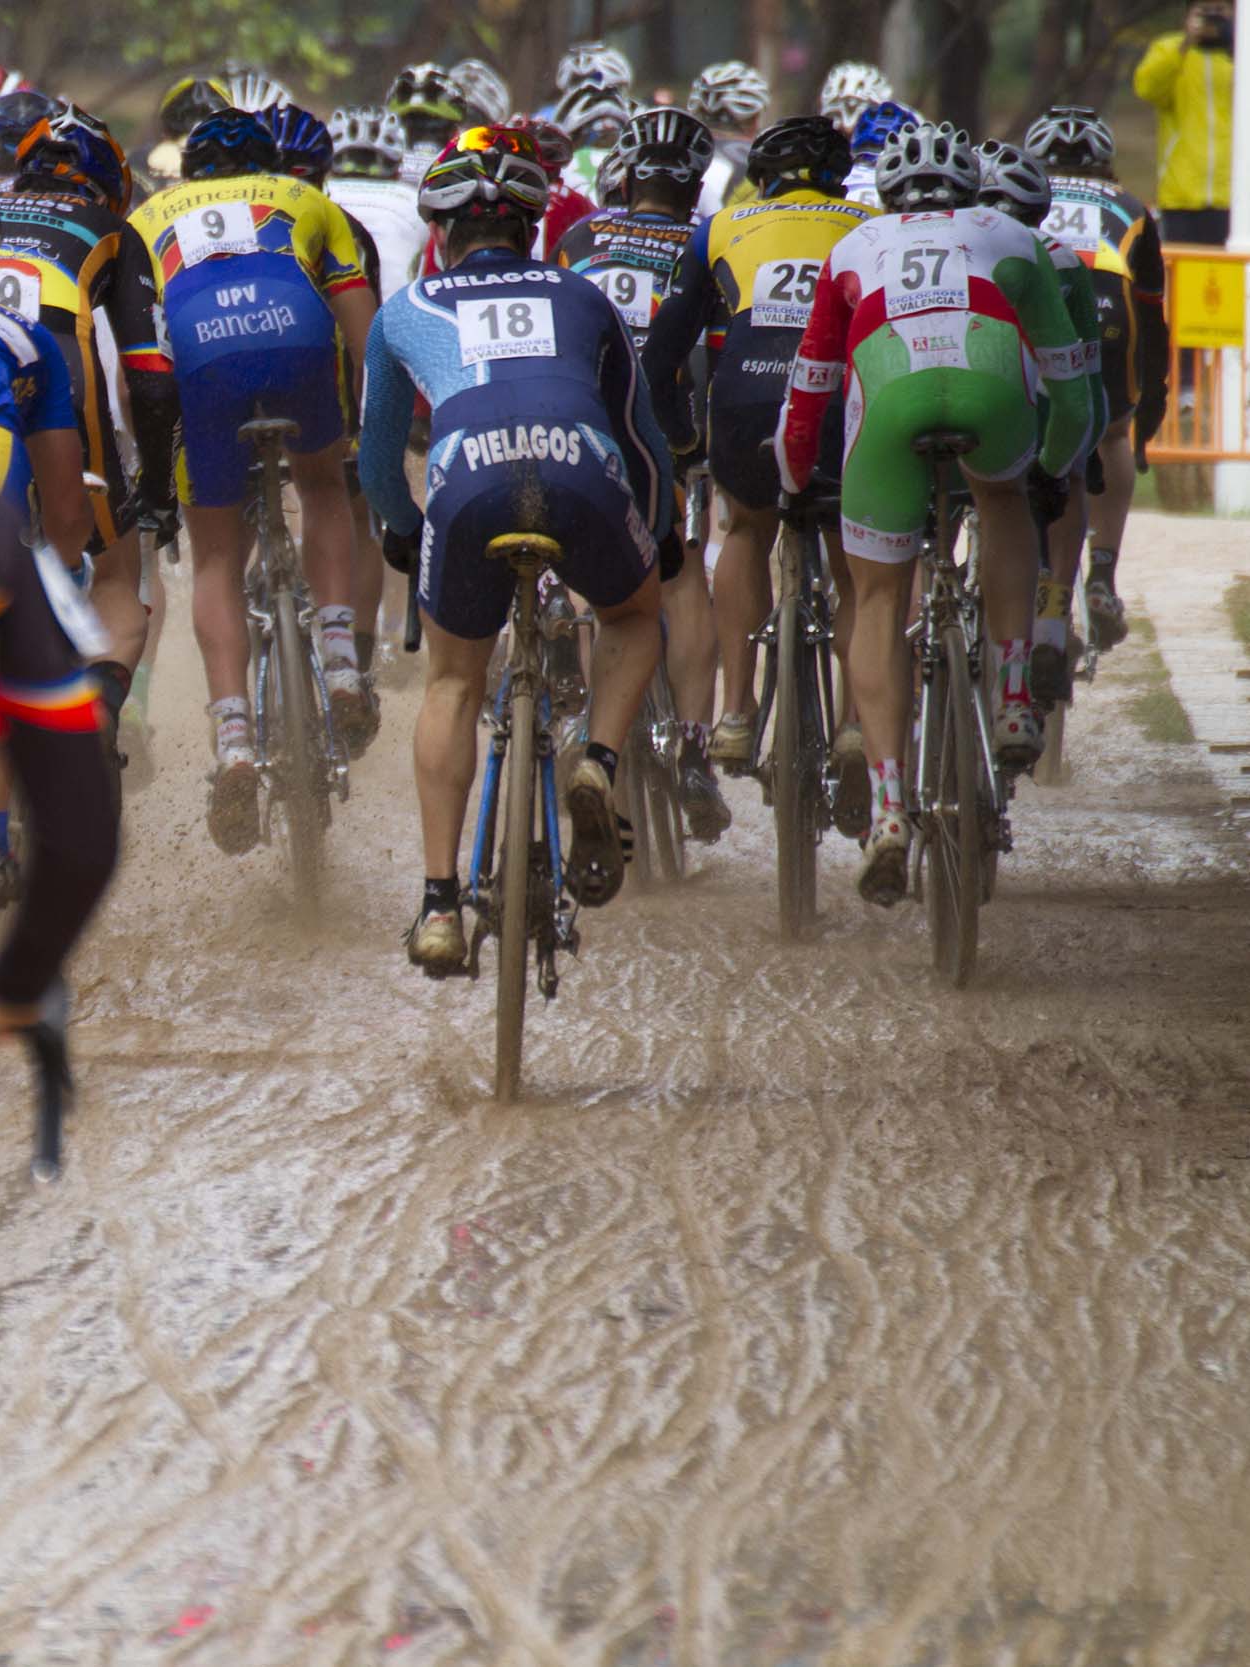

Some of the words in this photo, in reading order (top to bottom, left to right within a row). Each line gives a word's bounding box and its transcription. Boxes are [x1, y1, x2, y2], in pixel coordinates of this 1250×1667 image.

[163, 185, 275, 220] Bancaja
[203, 210, 226, 240] 9
[589, 223, 689, 243] VALENCI
[1048, 205, 1088, 235] 34
[424, 270, 562, 297] PIELAGOS
[768, 264, 821, 304] 25
[901, 249, 950, 291] 57
[215, 283, 257, 308] UPV
[754, 304, 811, 316] CICLOCRO
[888, 289, 965, 305] CICLOCROSS
[899, 296, 955, 312] VALENCIA
[195, 299, 296, 344] Bancaja
[478, 303, 534, 340] 18
[477, 346, 540, 359] VALENCIA
[462, 424, 582, 472] PIELAGOS
